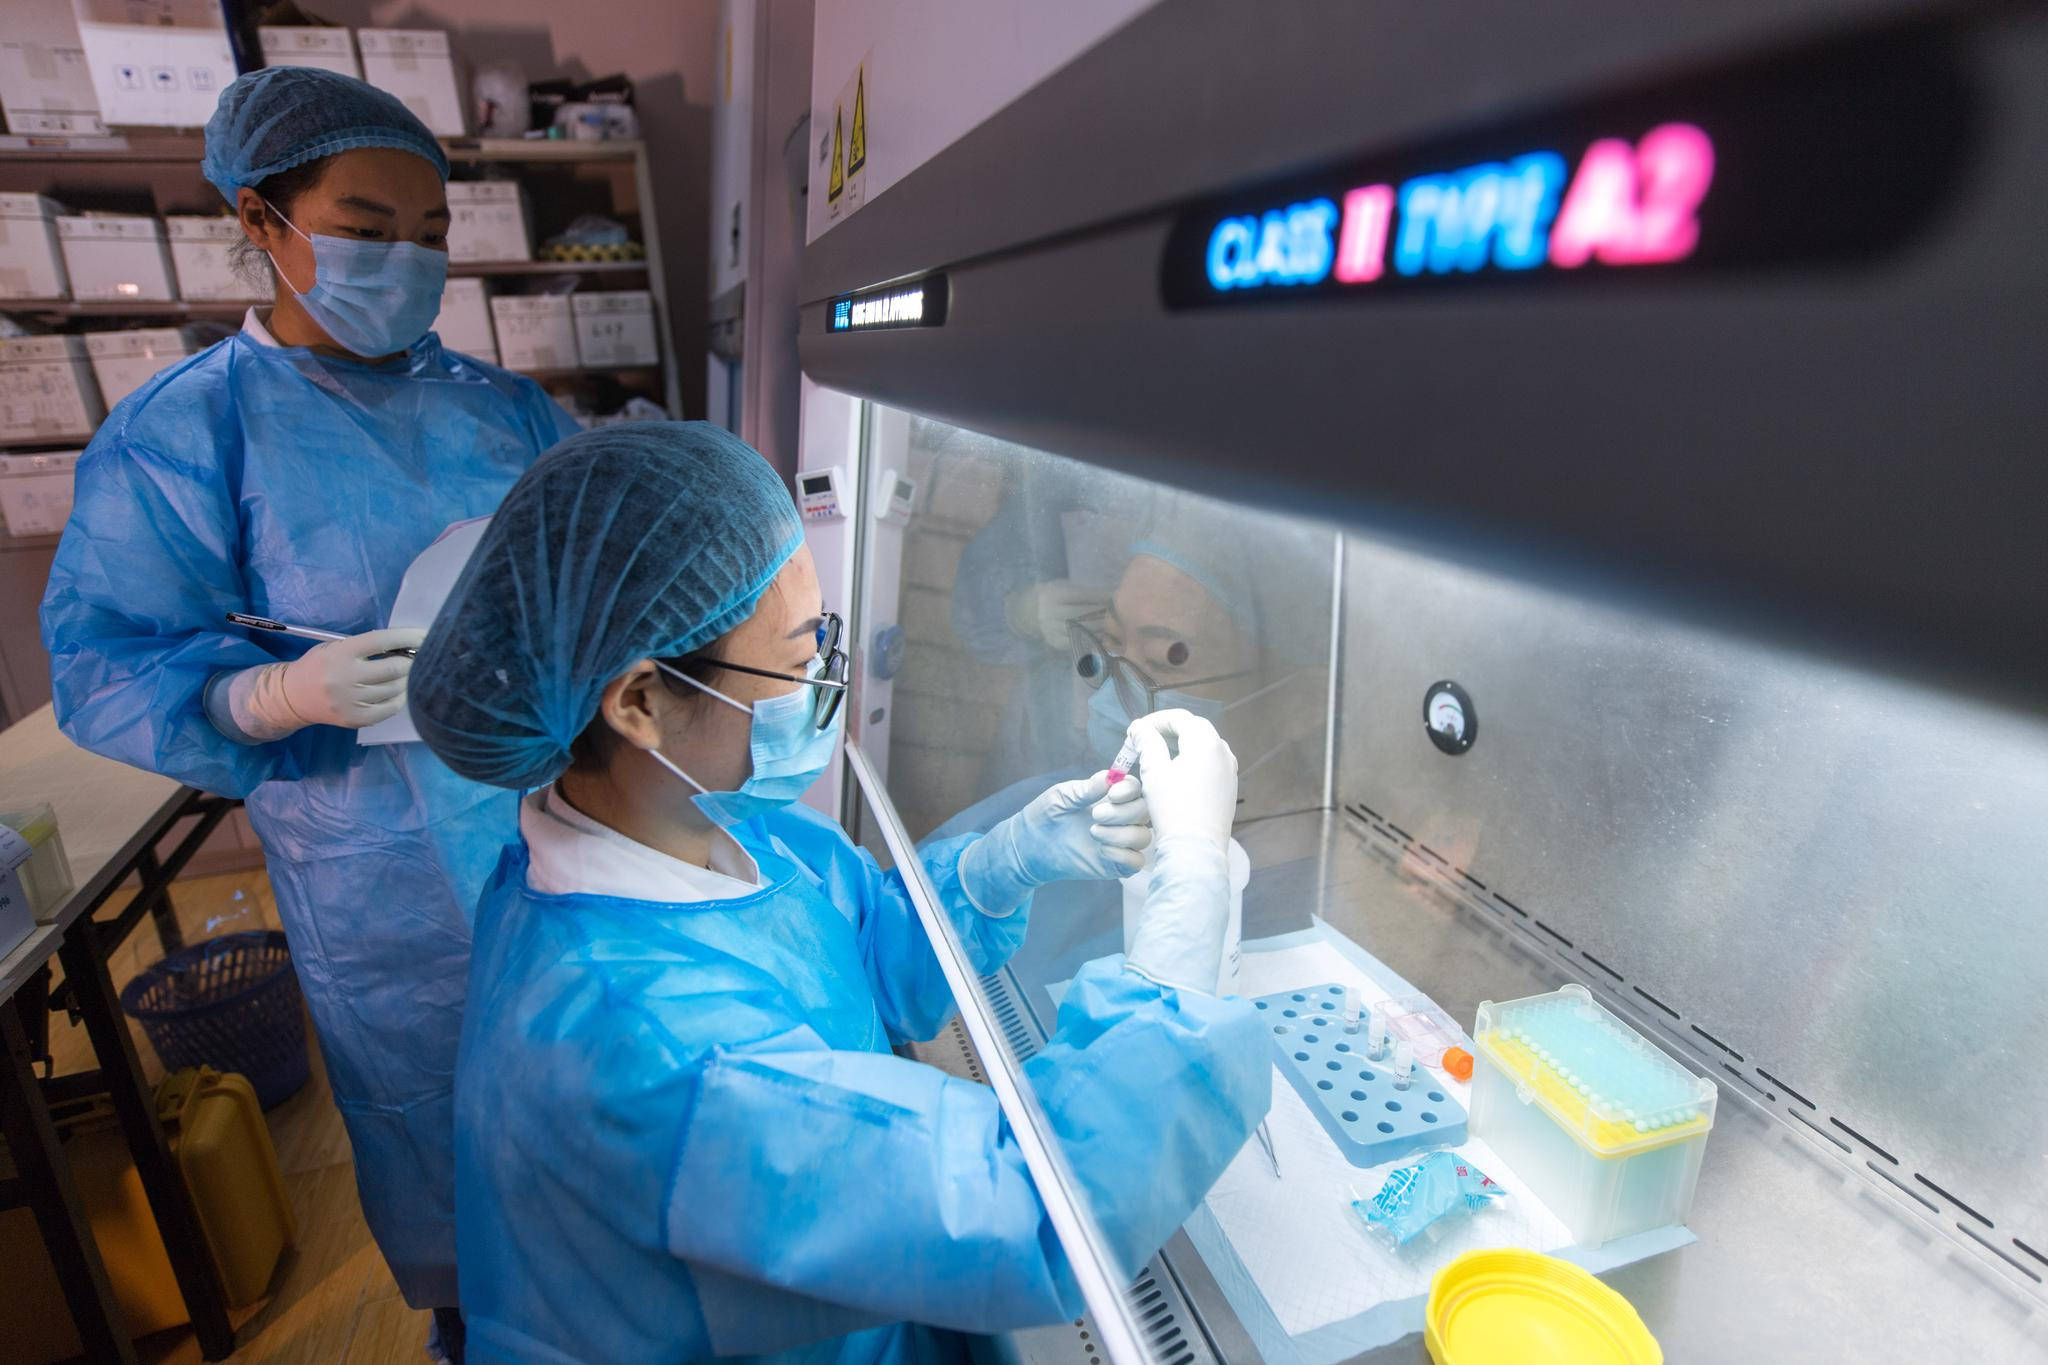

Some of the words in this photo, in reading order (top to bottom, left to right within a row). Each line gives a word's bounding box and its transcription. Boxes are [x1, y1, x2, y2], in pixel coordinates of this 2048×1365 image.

[1207, 198, 1336, 290] CLASS
[1335, 184, 1394, 284] II
[1394, 151, 1567, 274] TYPE
[1549, 122, 1715, 268] A2
